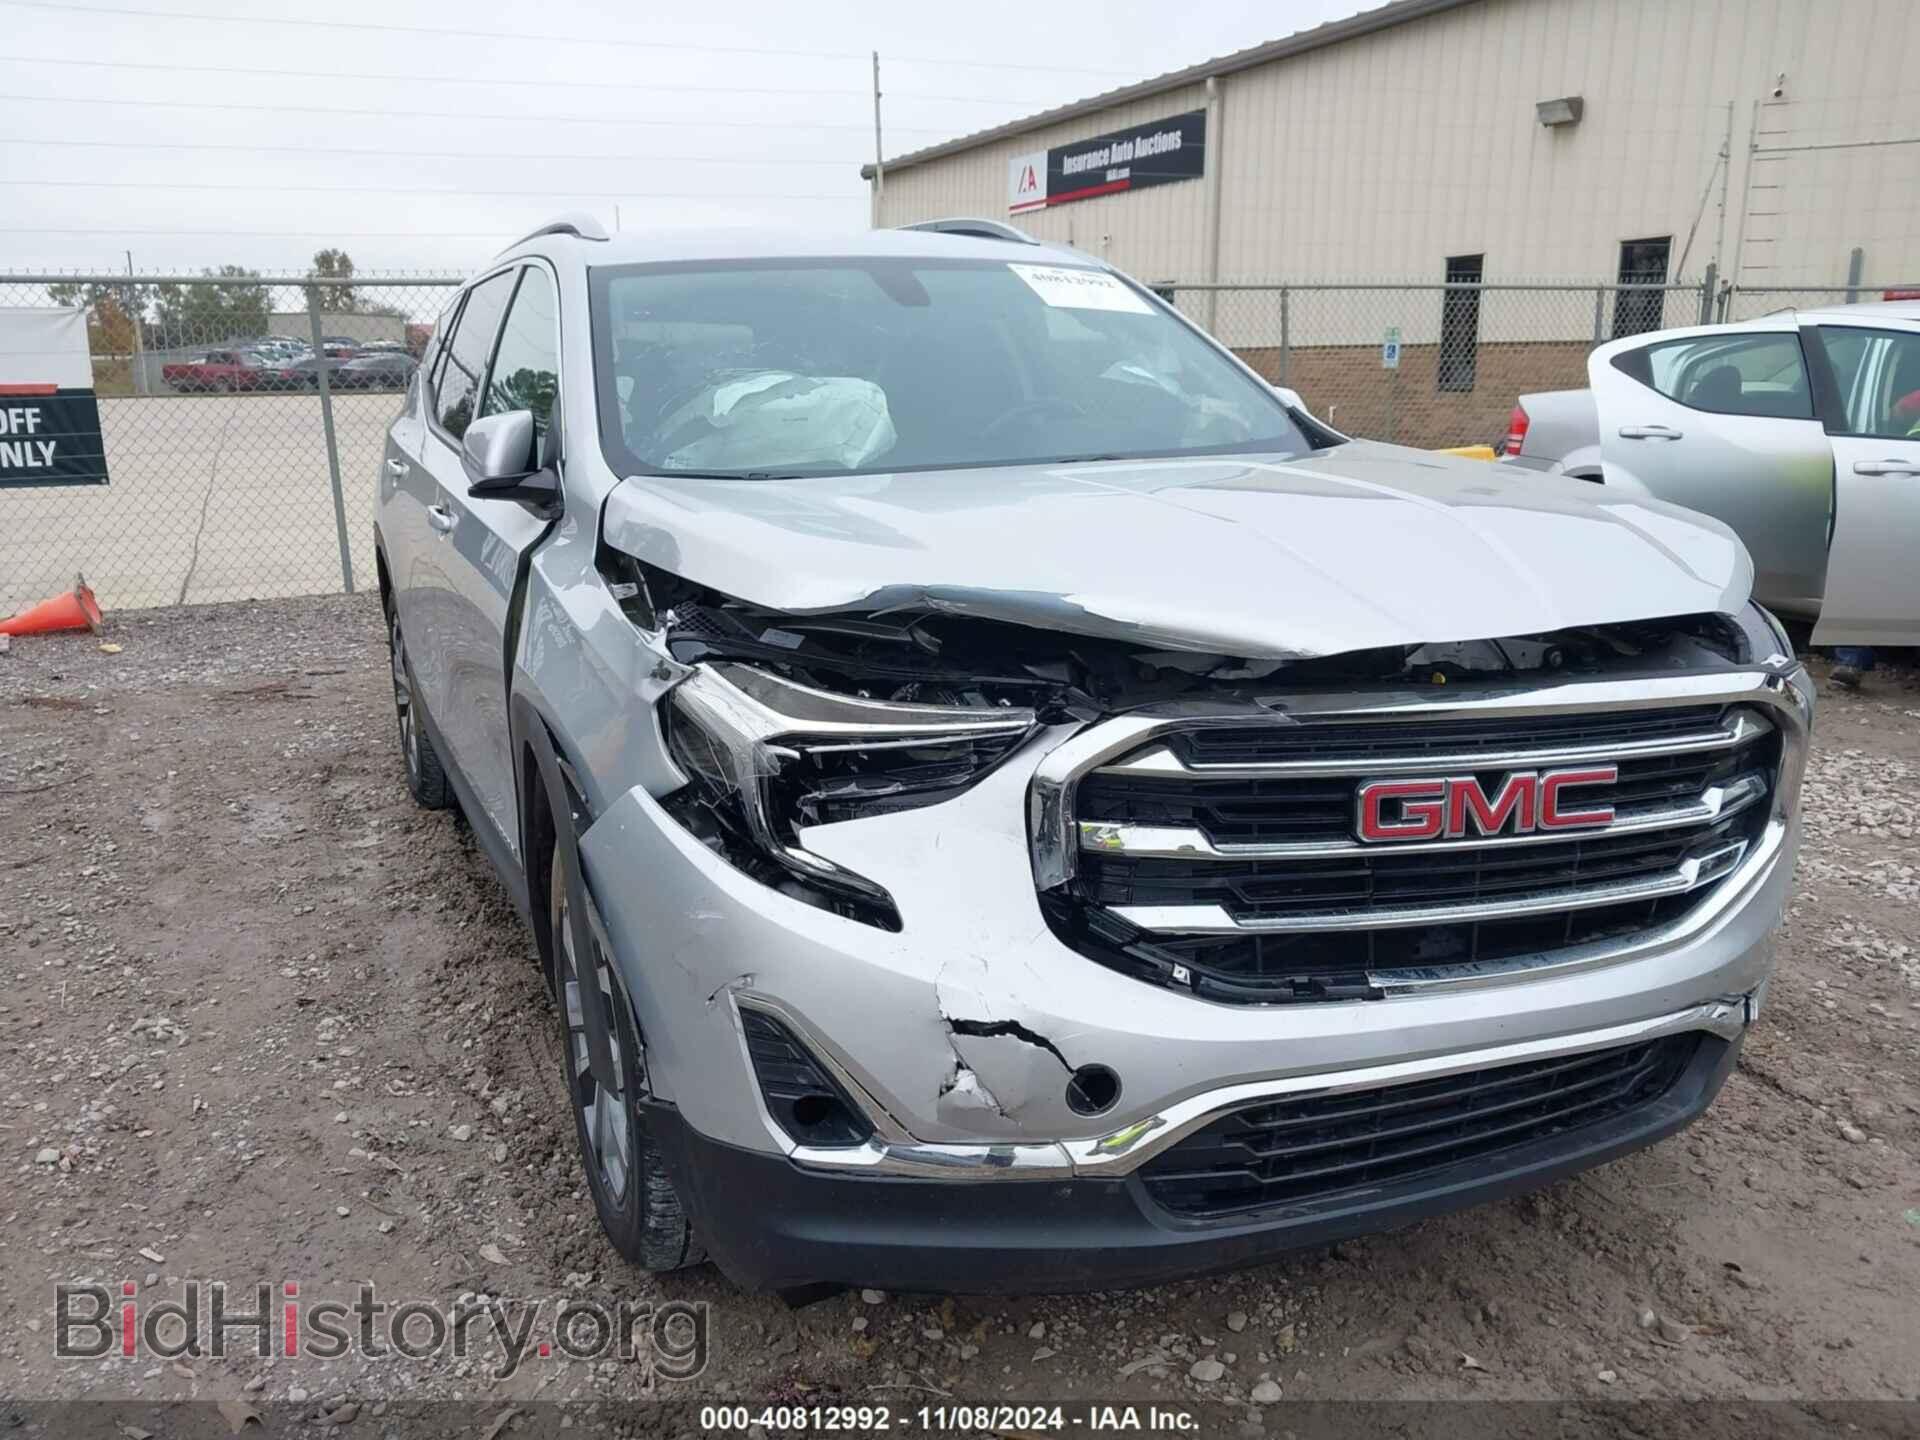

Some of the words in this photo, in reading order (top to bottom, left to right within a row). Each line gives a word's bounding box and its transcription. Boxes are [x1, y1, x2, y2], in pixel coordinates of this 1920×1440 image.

[1063, 148, 1109, 175] Insurance
[1110, 141, 1134, 165] Auto
[1134, 130, 1182, 158] Auctions
[0, 440, 56, 468] NLY
[1357, 765, 1618, 842] GMC
